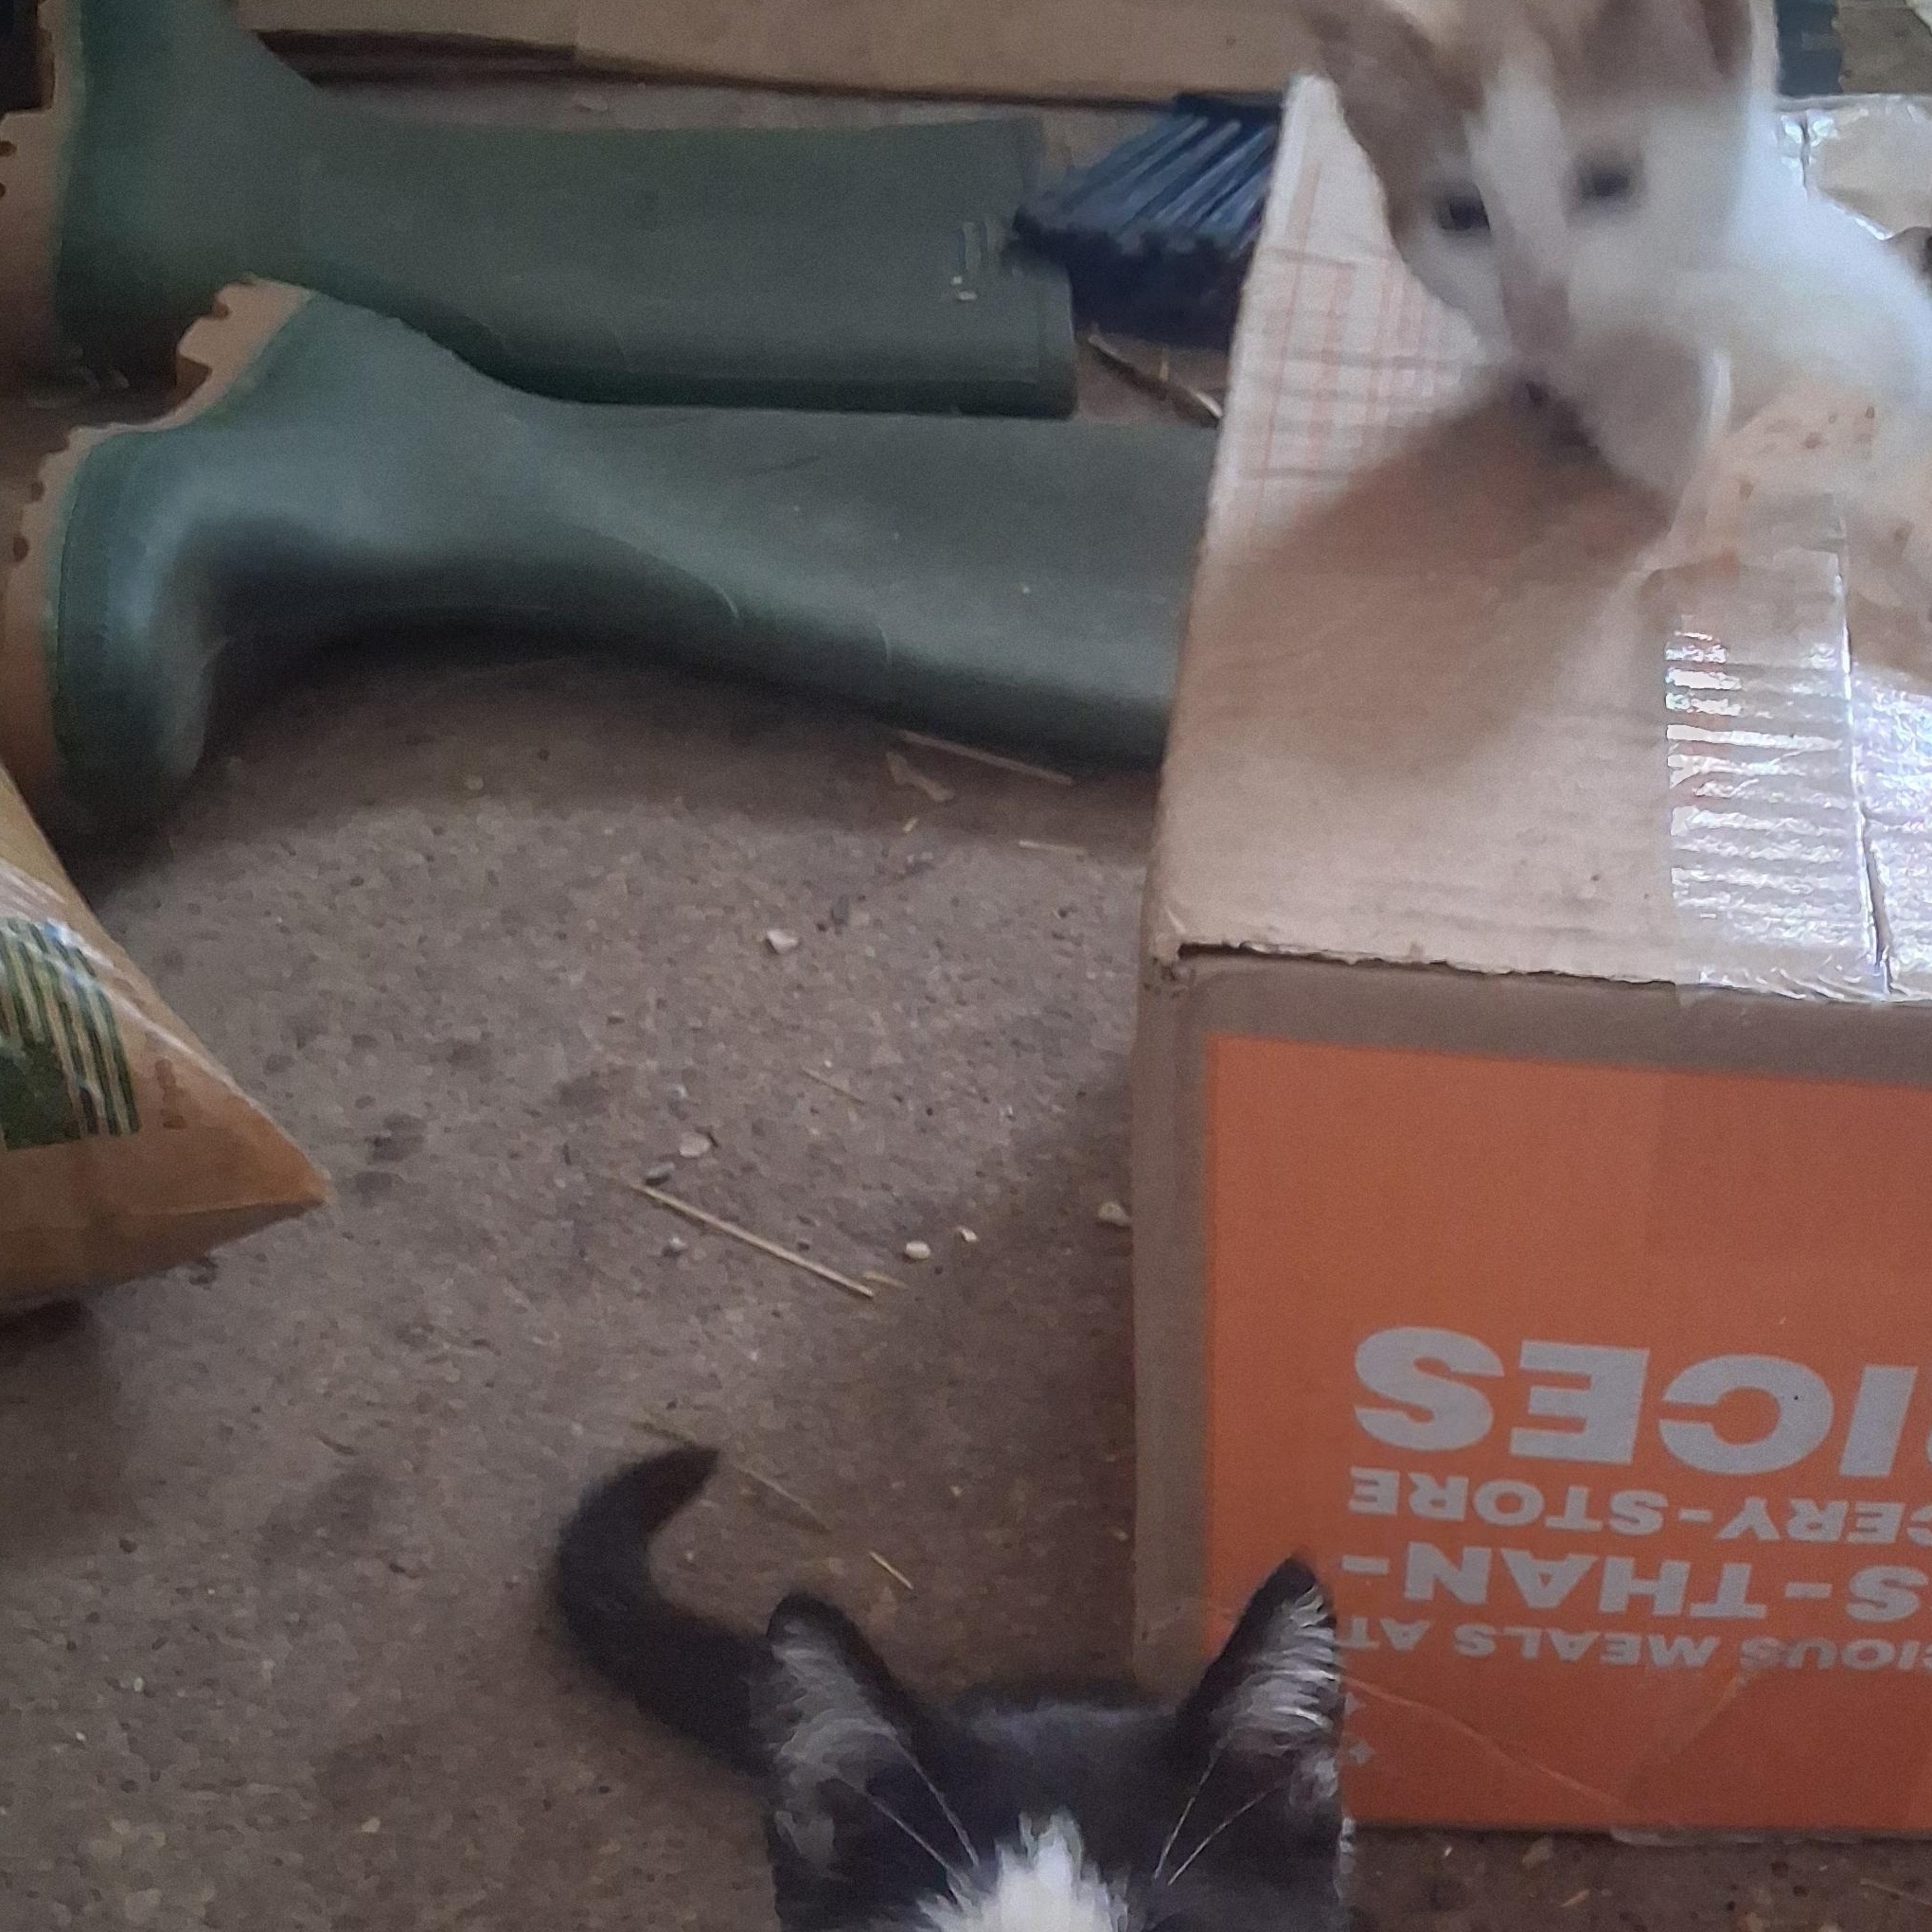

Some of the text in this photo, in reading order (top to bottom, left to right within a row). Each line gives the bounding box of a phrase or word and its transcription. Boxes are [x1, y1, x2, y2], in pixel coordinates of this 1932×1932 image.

[1354, 1326, 1932, 1479] ICES
[1340, 1541, 1932, 1623] S-THAN-
[1335, 1617, 1429, 1651] AT
[1453, 1622, 1721, 1668] MEALS
